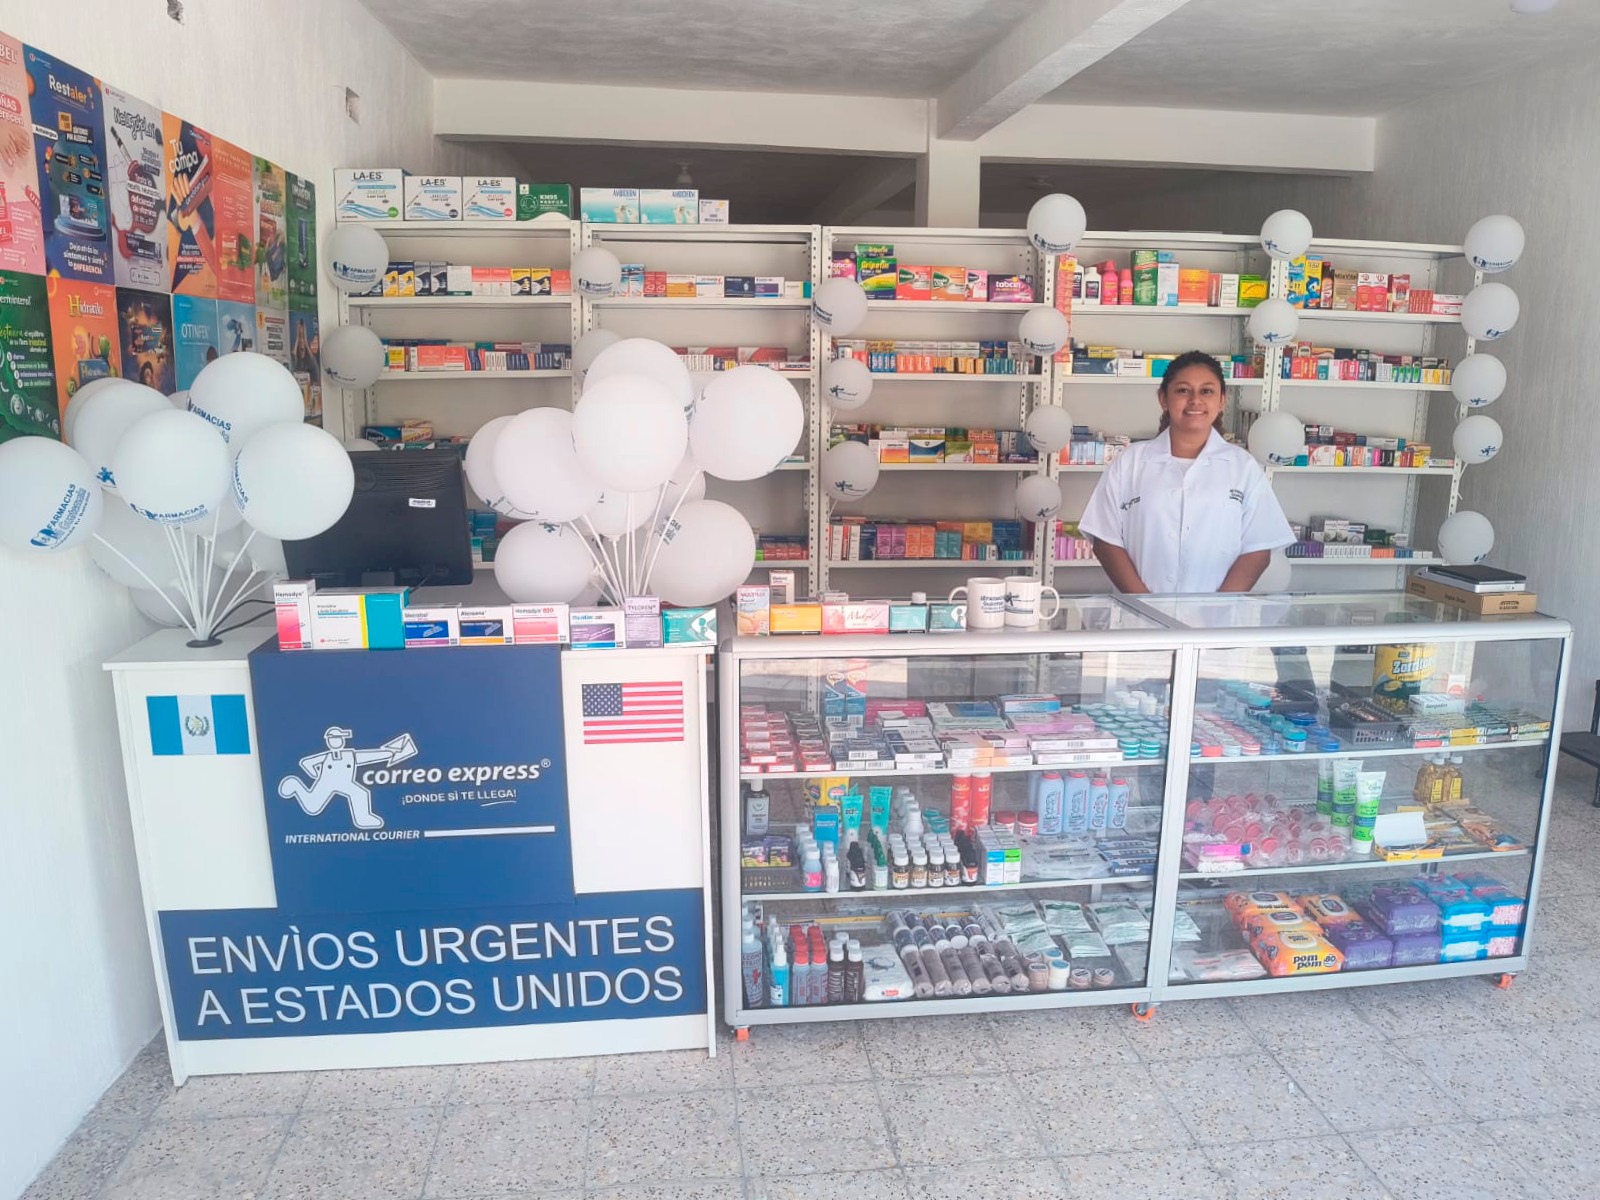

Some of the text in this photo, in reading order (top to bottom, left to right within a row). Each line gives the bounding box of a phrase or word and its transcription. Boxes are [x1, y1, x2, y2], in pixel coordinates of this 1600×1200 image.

[48, 74, 87, 105] Restaler
[169, 139, 183, 156] Tu
[168, 151, 199, 172] compa
[353, 171, 382, 180] LA-ES
[420, 178, 446, 186] LA-ES
[477, 179, 502, 187] LA-ES
[995, 280, 1021, 288] tabcin
[189, 403, 232, 432] FARMACIAS
[46, 483, 76, 531] FARMACIAS
[153, 503, 206, 519] FARMACIAS
[362, 767, 442, 787] correo
[402, 793, 446, 806] ¡DONDE
[460, 790, 476, 801] TE
[477, 788, 517, 800] LLEGA!
[285, 830, 420, 844] INTERNATIONAL COURIER
[396, 915, 676, 967] URGENTES
[1292, 954, 1319, 964] pom
[1296, 961, 1323, 970] pom
[197, 965, 684, 1026] A ESTADOS UNIDOS
